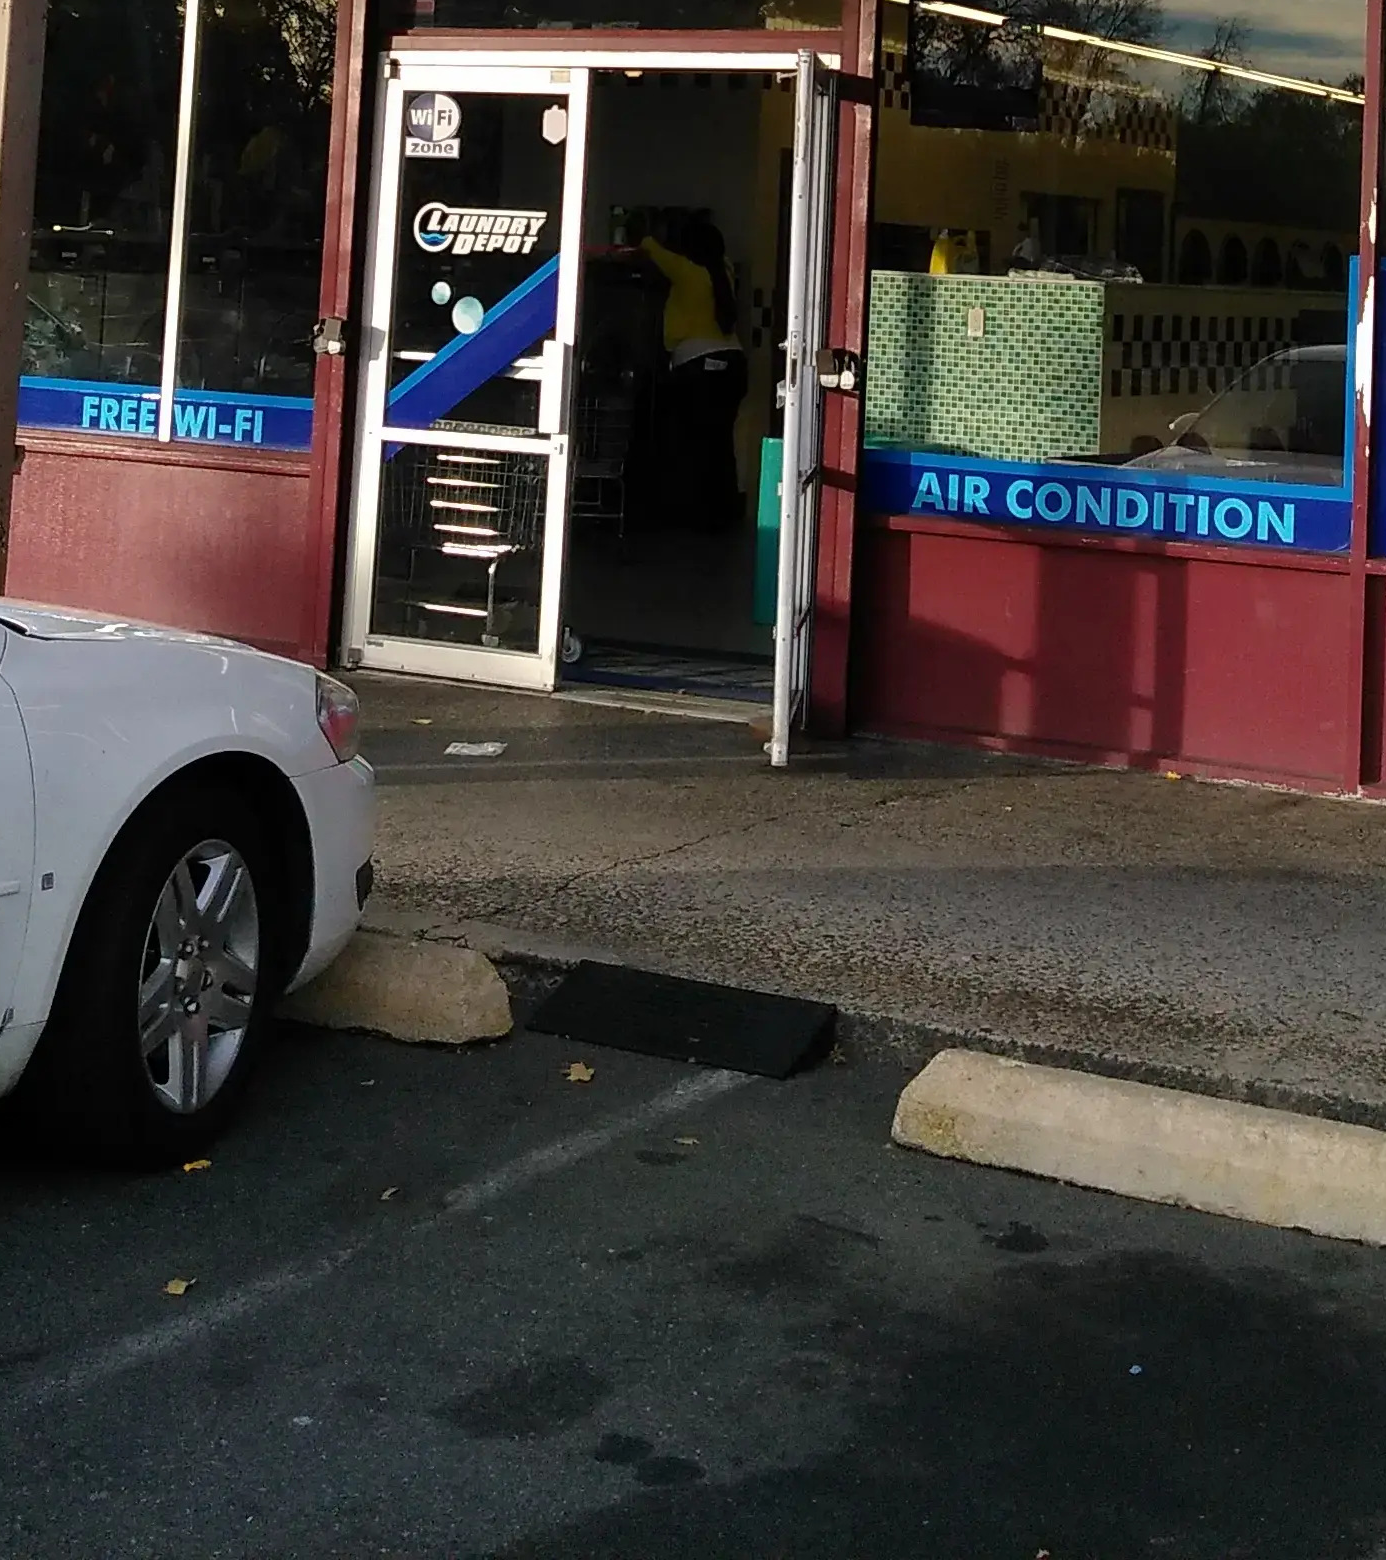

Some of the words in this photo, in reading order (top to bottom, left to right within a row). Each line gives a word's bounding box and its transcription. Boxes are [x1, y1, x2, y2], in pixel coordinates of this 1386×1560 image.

[411, 142, 454, 154] zone
[427, 210, 546, 235] LAUNDRY
[452, 233, 538, 255] DEPOT
[82, 396, 155, 433] FREE
[174, 406, 264, 444] WI-FI
[912, 472, 990, 514] AIR
[1005, 479, 1296, 543] CONDITION
